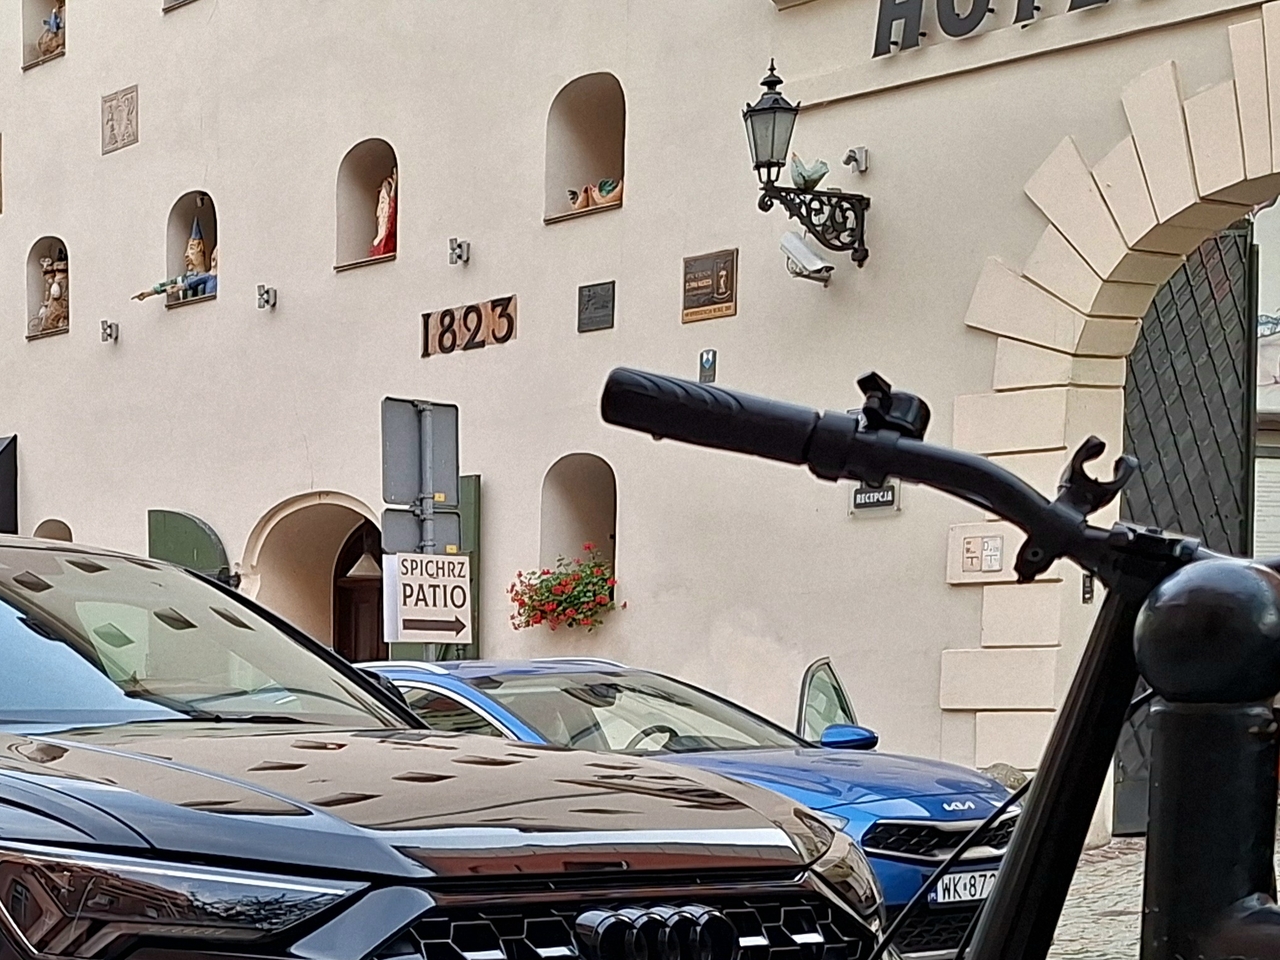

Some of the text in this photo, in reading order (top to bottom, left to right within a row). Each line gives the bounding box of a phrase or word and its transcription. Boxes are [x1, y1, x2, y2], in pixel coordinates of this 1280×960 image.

[421, 296, 514, 358] 1823
[856, 490, 893, 504] RECEPCJA
[401, 558, 466, 579] SPICHRZ
[401, 583, 467, 609] PATIO
[942, 876, 962, 900] WK
